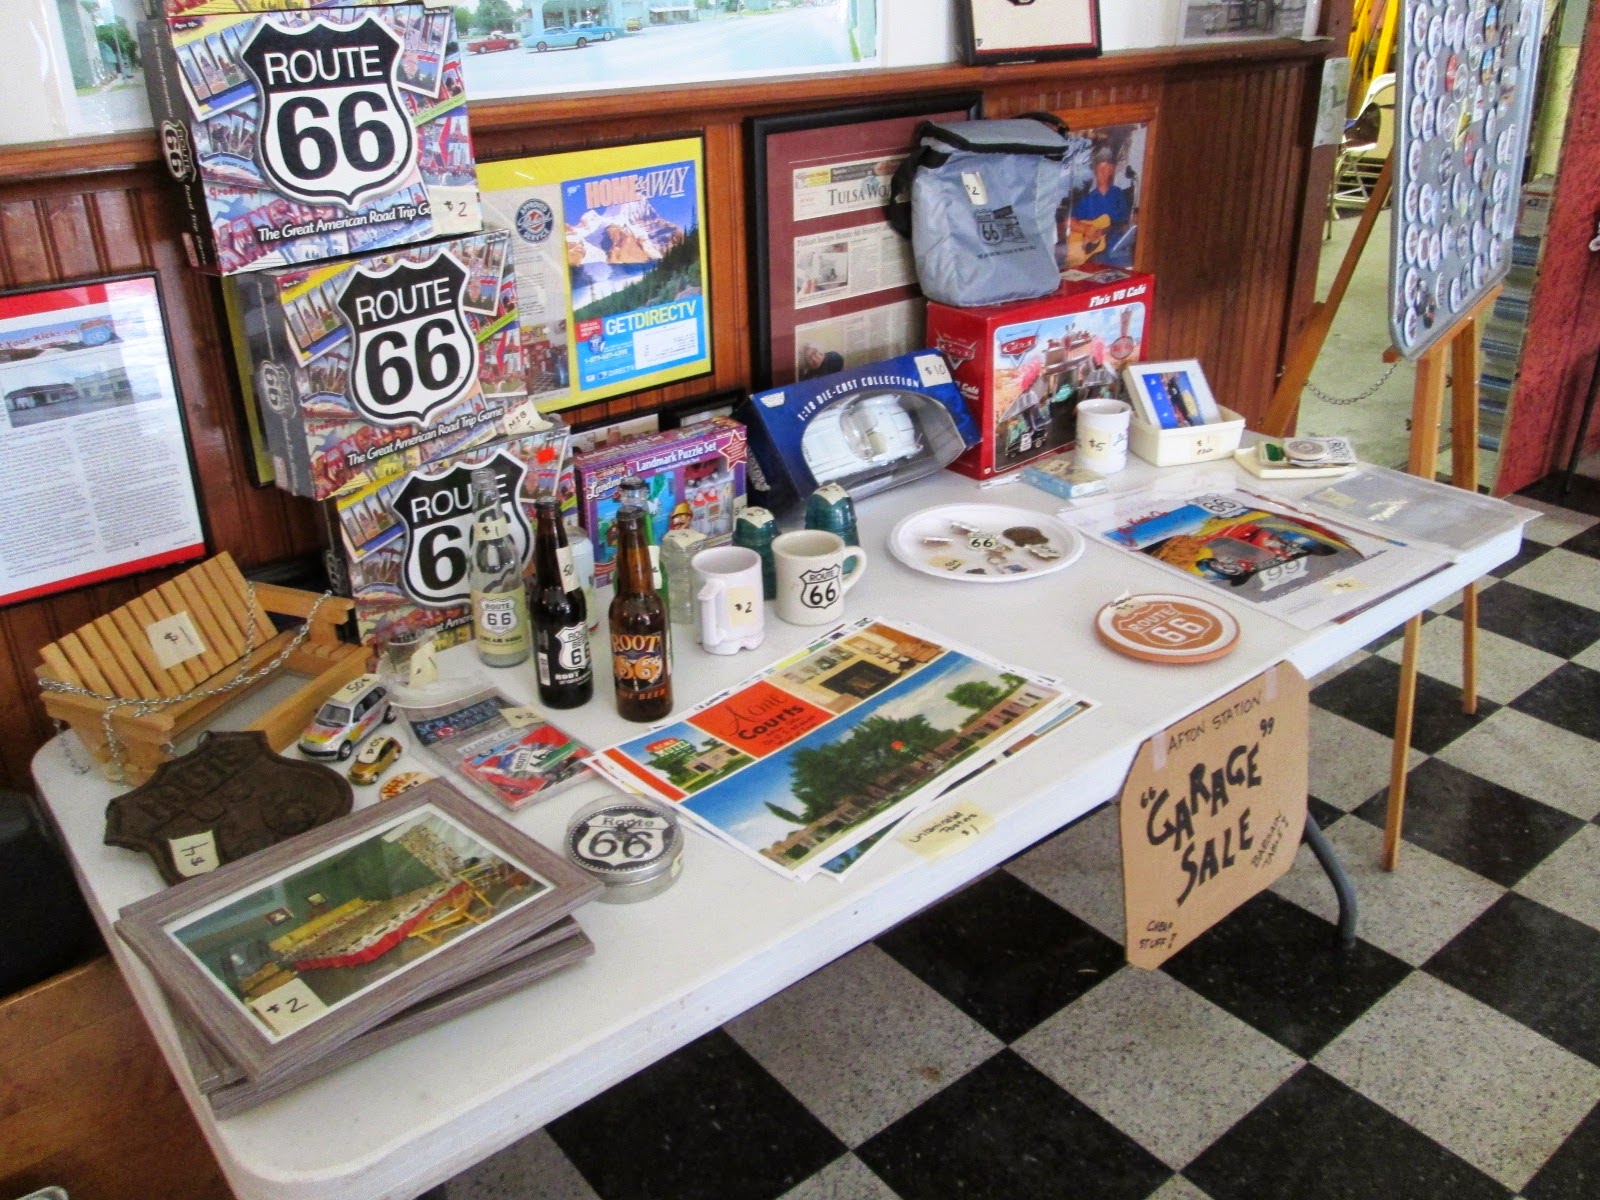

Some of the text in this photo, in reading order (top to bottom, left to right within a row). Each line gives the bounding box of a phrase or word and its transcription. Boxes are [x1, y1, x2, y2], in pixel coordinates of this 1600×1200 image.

[264, 44, 384, 86] ROUTE
[277, 90, 396, 180] 66
[827, 185, 865, 207] TULSA
[444, 201, 468, 217] $2
[258, 227, 280, 242] The
[281, 222, 315, 237] Great
[315, 215, 368, 233] American
[369, 208, 397, 224] Road
[398, 204, 417, 220] Trip
[355, 277, 453, 325] ROUTE
[1088, 294, 1111, 308] Flo's
[1126, 284, 1147, 298] Café
[6, 334, 31, 349] Your
[33, 329, 61, 343] Kicks
[64, 328, 78, 337] on
[1001, 336, 1037, 354] Cars
[365, 317, 460, 406] 66
[925, 365, 946, 377] $10
[816, 377, 859, 405] DIE-CAST
[861, 375, 920, 388] COLLECTION
[347, 407, 505, 467] The Great American Road Trip Game
[1089, 437, 1106, 452] $5
[636, 452, 678, 472] Landmark
[677, 445, 703, 463] Puzzle
[703, 441, 718, 453] Set
[410, 473, 510, 524] ROUE
[1202, 498, 1237, 513] 66
[970, 538, 994, 549] 66
[809, 568, 836, 582] ROUTE
[808, 583, 837, 606] 66
[484, 602, 512, 612] ROUTE
[735, 601, 753, 614] $2
[487, 612, 512, 627] 66
[1128, 608, 1177, 631] ROUTE
[1151, 617, 1205, 643] 66
[163, 625, 196, 646] $1
[738, 704, 806, 742] Courts
[1167, 690, 1263, 755] AFTON STATION
[602, 816, 655, 828] Route
[588, 829, 654, 859] 66
[1176, 807, 1254, 908] SALE
[264, 996, 309, 1015] $2
